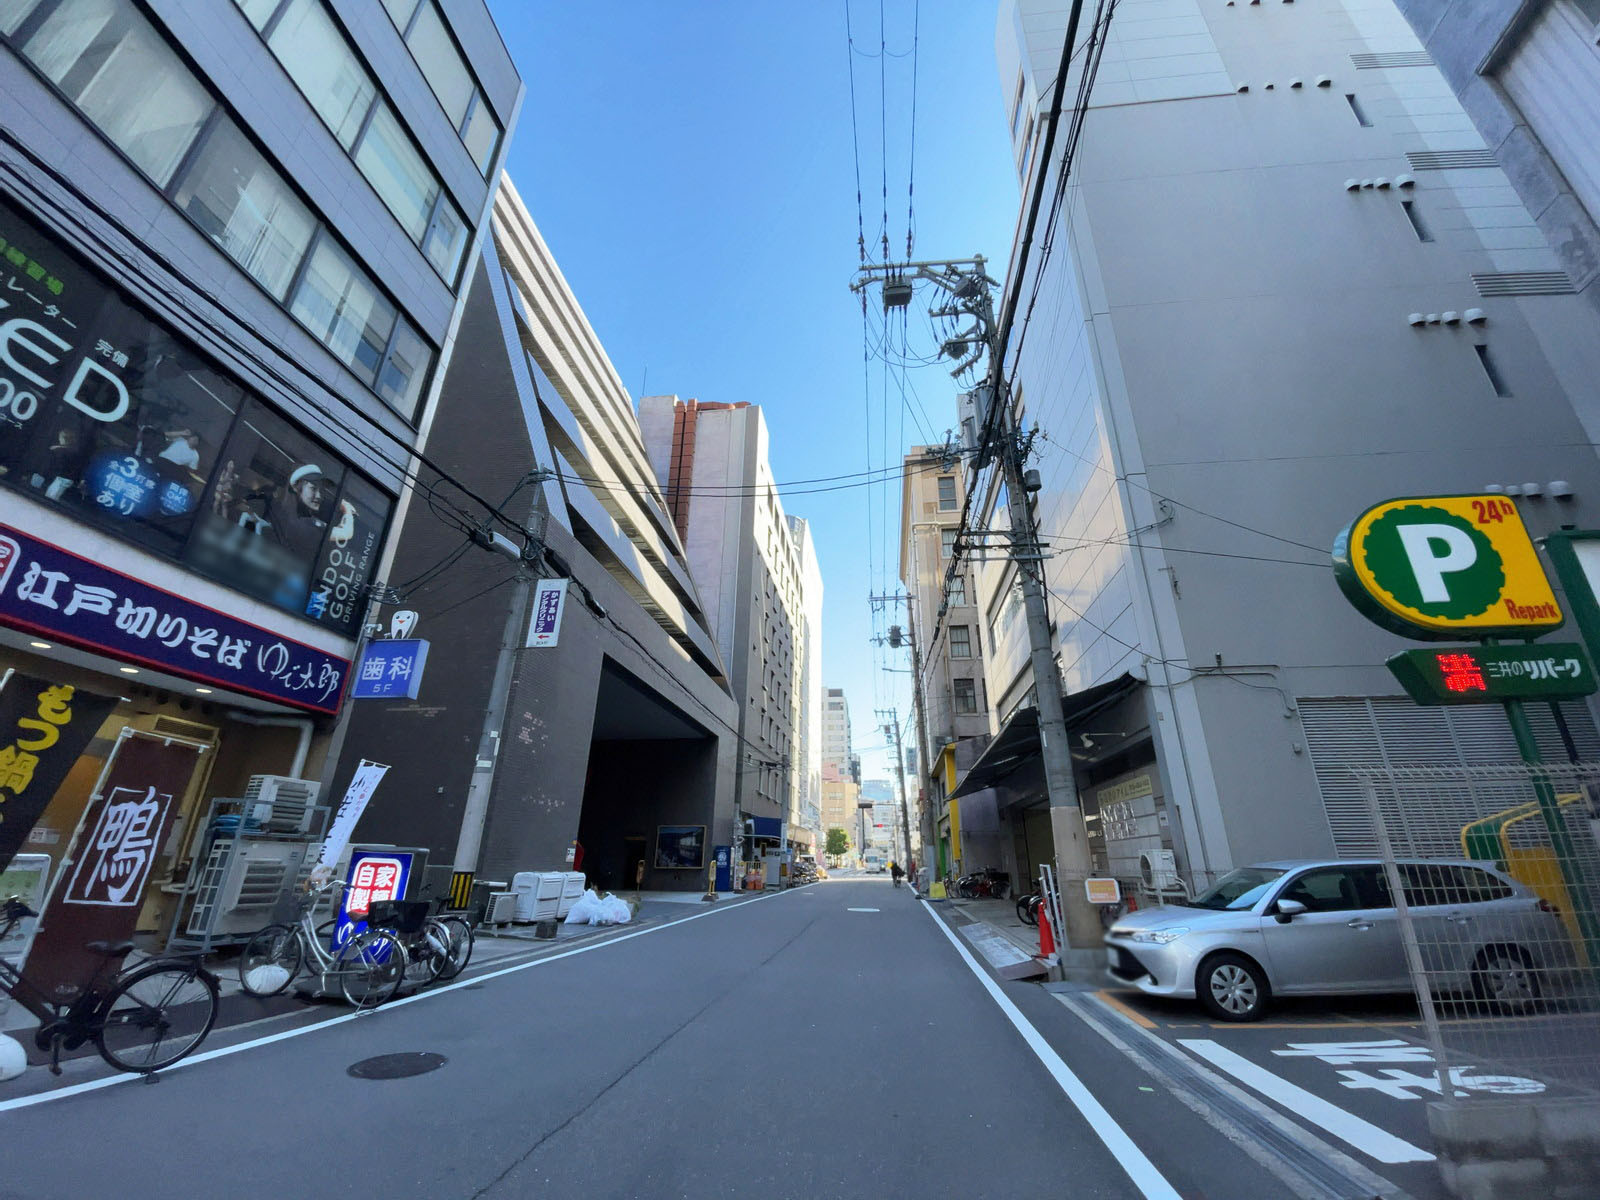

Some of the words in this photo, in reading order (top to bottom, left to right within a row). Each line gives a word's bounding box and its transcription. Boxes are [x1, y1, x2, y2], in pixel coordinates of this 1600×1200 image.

[0, 271, 77, 329] レーター
[0, 298, 130, 422] ED
[95, 339, 129, 368] 完備
[96, 490, 135, 515] あり
[104, 472, 145, 503] 個室
[1472, 499, 1515, 524] 24h
[342, 573, 363, 623] DRIVING
[358, 531, 376, 570] RANGE
[1396, 523, 1478, 604] P
[329, 551, 356, 619] GOLF
[1503, 598, 1558, 622] Repark
[17, 561, 251, 670] 江戸切りそば
[257, 642, 341, 703] ゆで太郎
[362, 656, 413, 681] 歯科
[1485, 658, 1581, 680] 三井のリパーク
[373, 683, 393, 693] 5F
[84, 786, 159, 903] 鴨
[357, 864, 397, 888] 自家
